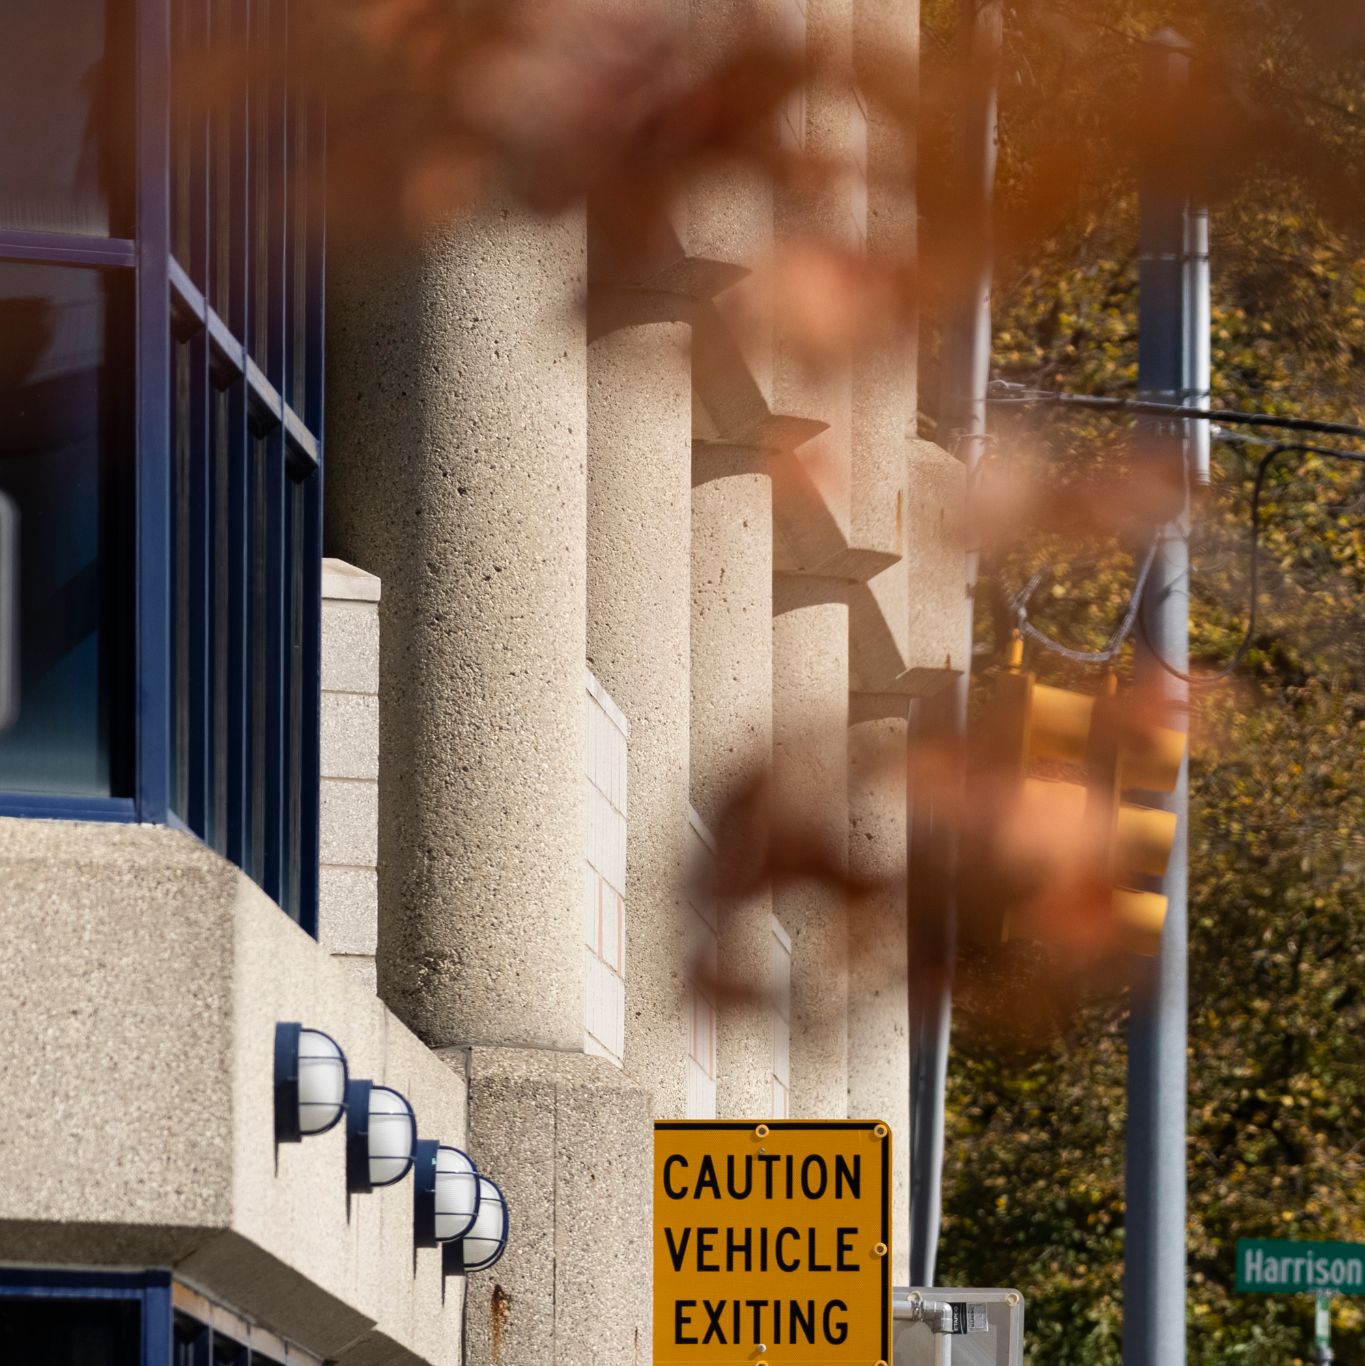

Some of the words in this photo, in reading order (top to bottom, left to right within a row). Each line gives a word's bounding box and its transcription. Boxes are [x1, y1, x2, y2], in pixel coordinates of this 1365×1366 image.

[663, 1154, 861, 1200] CAUTION
[664, 1226, 860, 1273] VEHICLE
[1244, 1248, 1362, 1286] Harrison
[674, 1299, 849, 1346] EXITING
